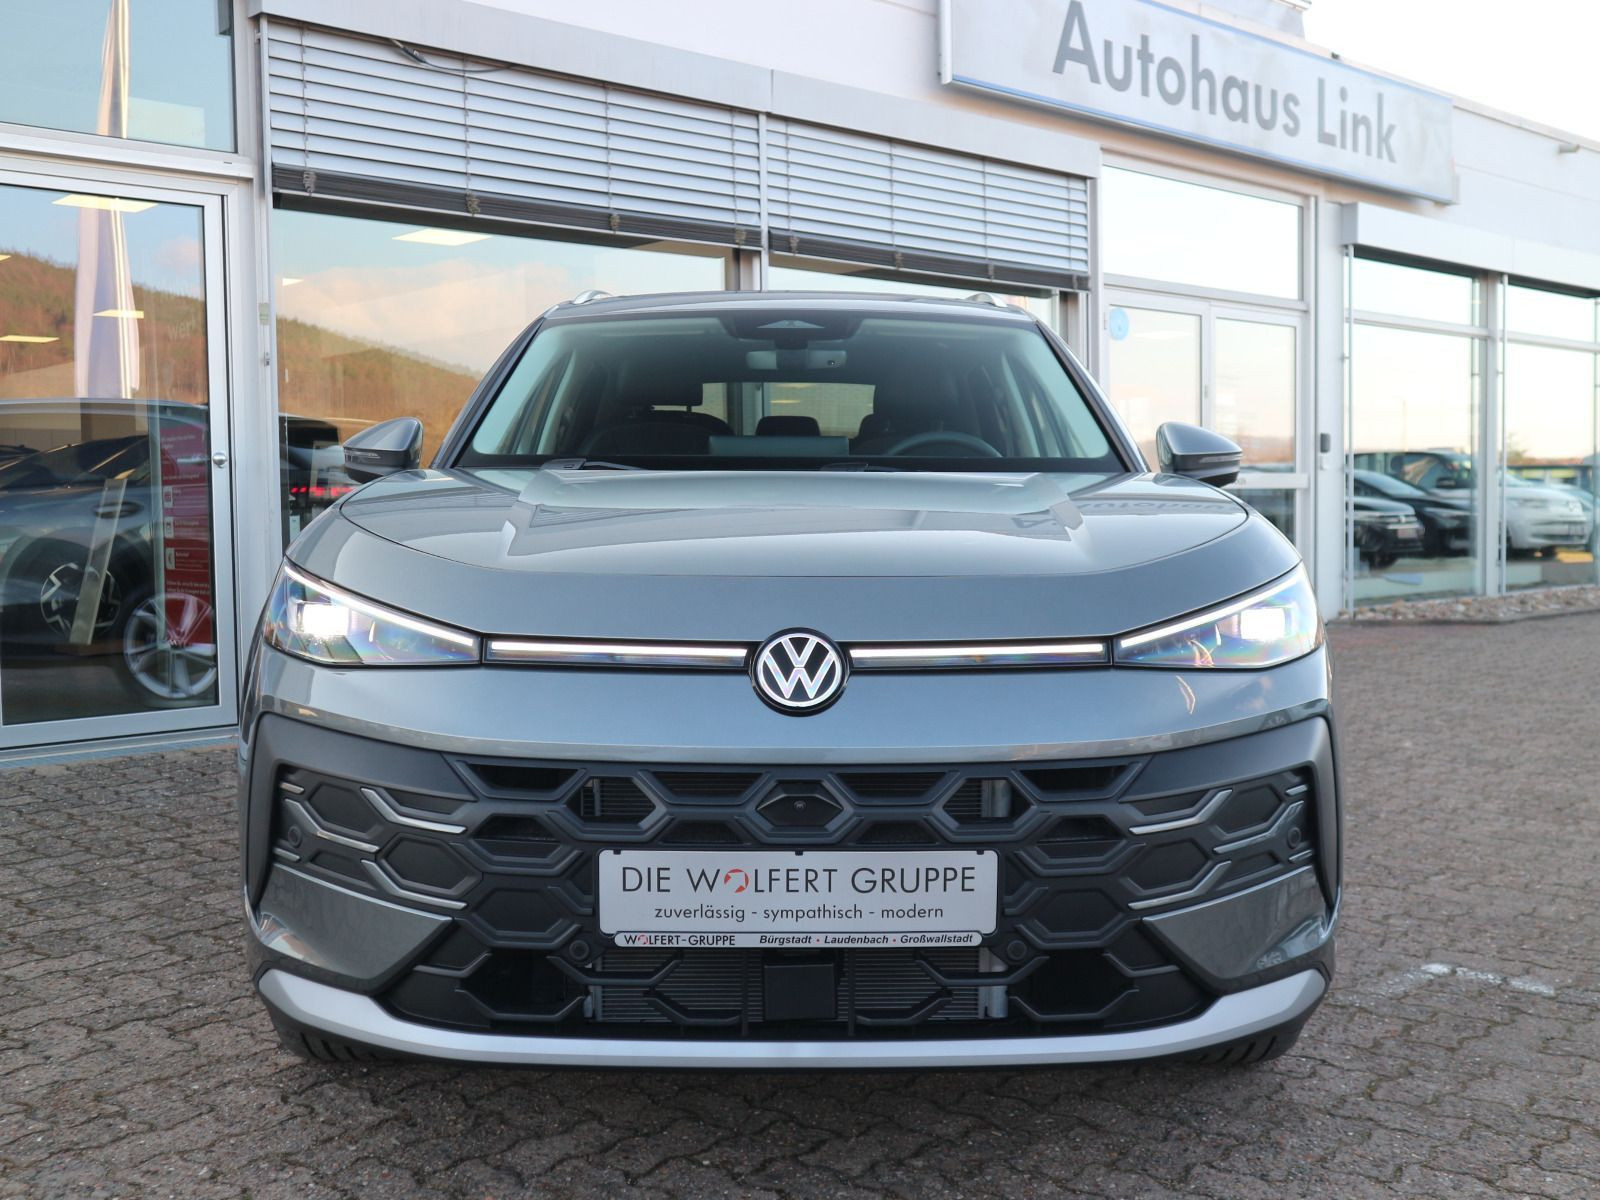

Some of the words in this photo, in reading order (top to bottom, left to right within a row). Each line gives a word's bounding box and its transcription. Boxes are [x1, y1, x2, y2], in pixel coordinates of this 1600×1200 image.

[1052, 0, 1300, 137] Autohaus
[1317, 77, 1396, 163] Link
[621, 866, 671, 893] DIE
[685, 867, 838, 894] WOLFERT
[850, 866, 976, 894] GRUPPE
[654, 903, 745, 923] zuverlässig
[763, 903, 863, 923] sympathisch
[881, 903, 944, 919] modern
[759, 933, 813, 946] Bürgstadt
[824, 933, 889, 945] Laudenbach
[900, 932, 973, 945] Großwallstadt
